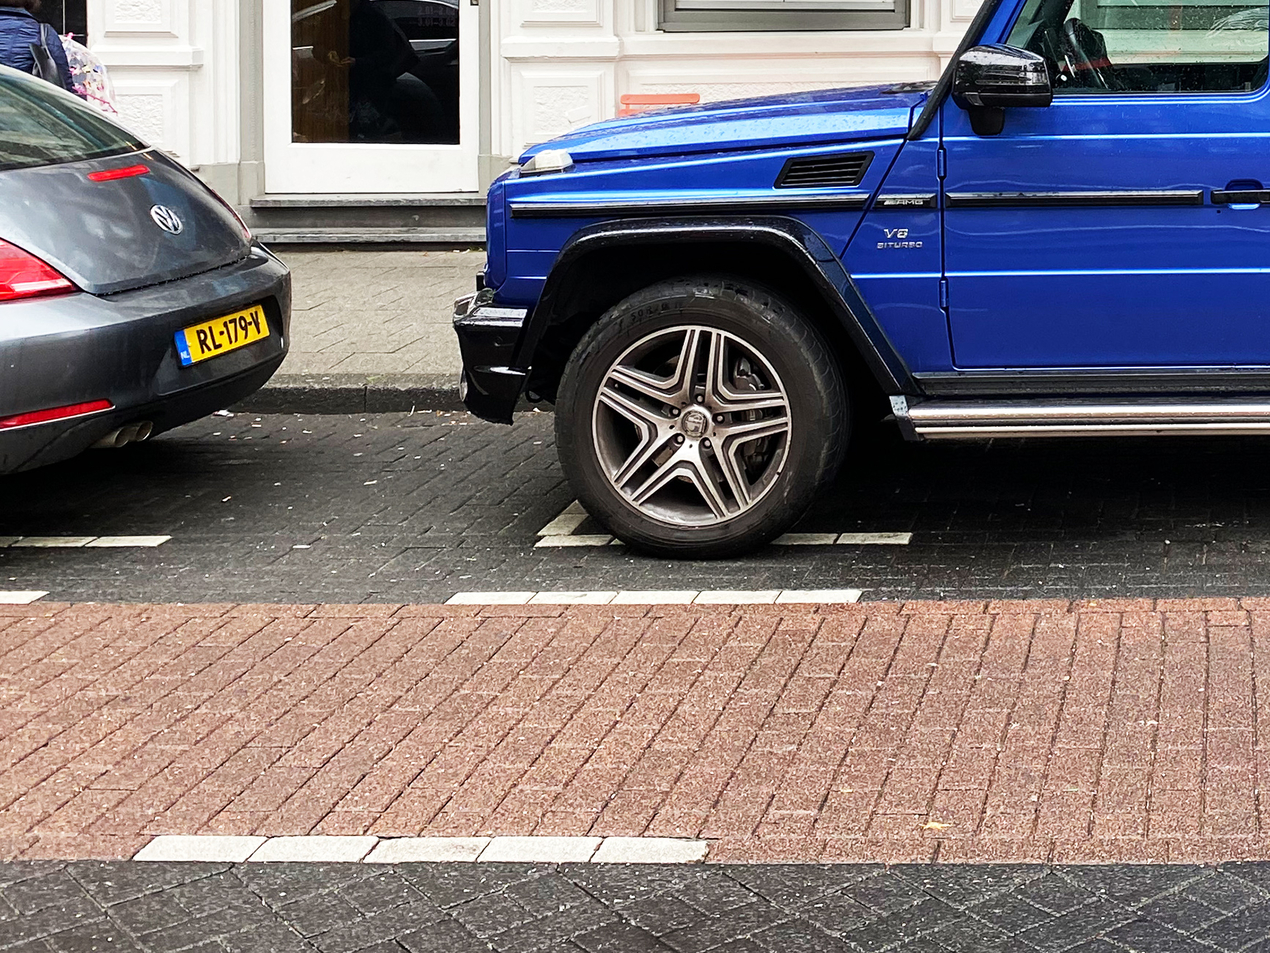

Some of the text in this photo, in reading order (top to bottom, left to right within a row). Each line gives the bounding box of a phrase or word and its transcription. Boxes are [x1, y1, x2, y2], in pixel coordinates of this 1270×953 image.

[883, 228, 909, 239] V8
[876, 241, 923, 249] BITURBO
[196, 310, 261, 355] RL-179-V
